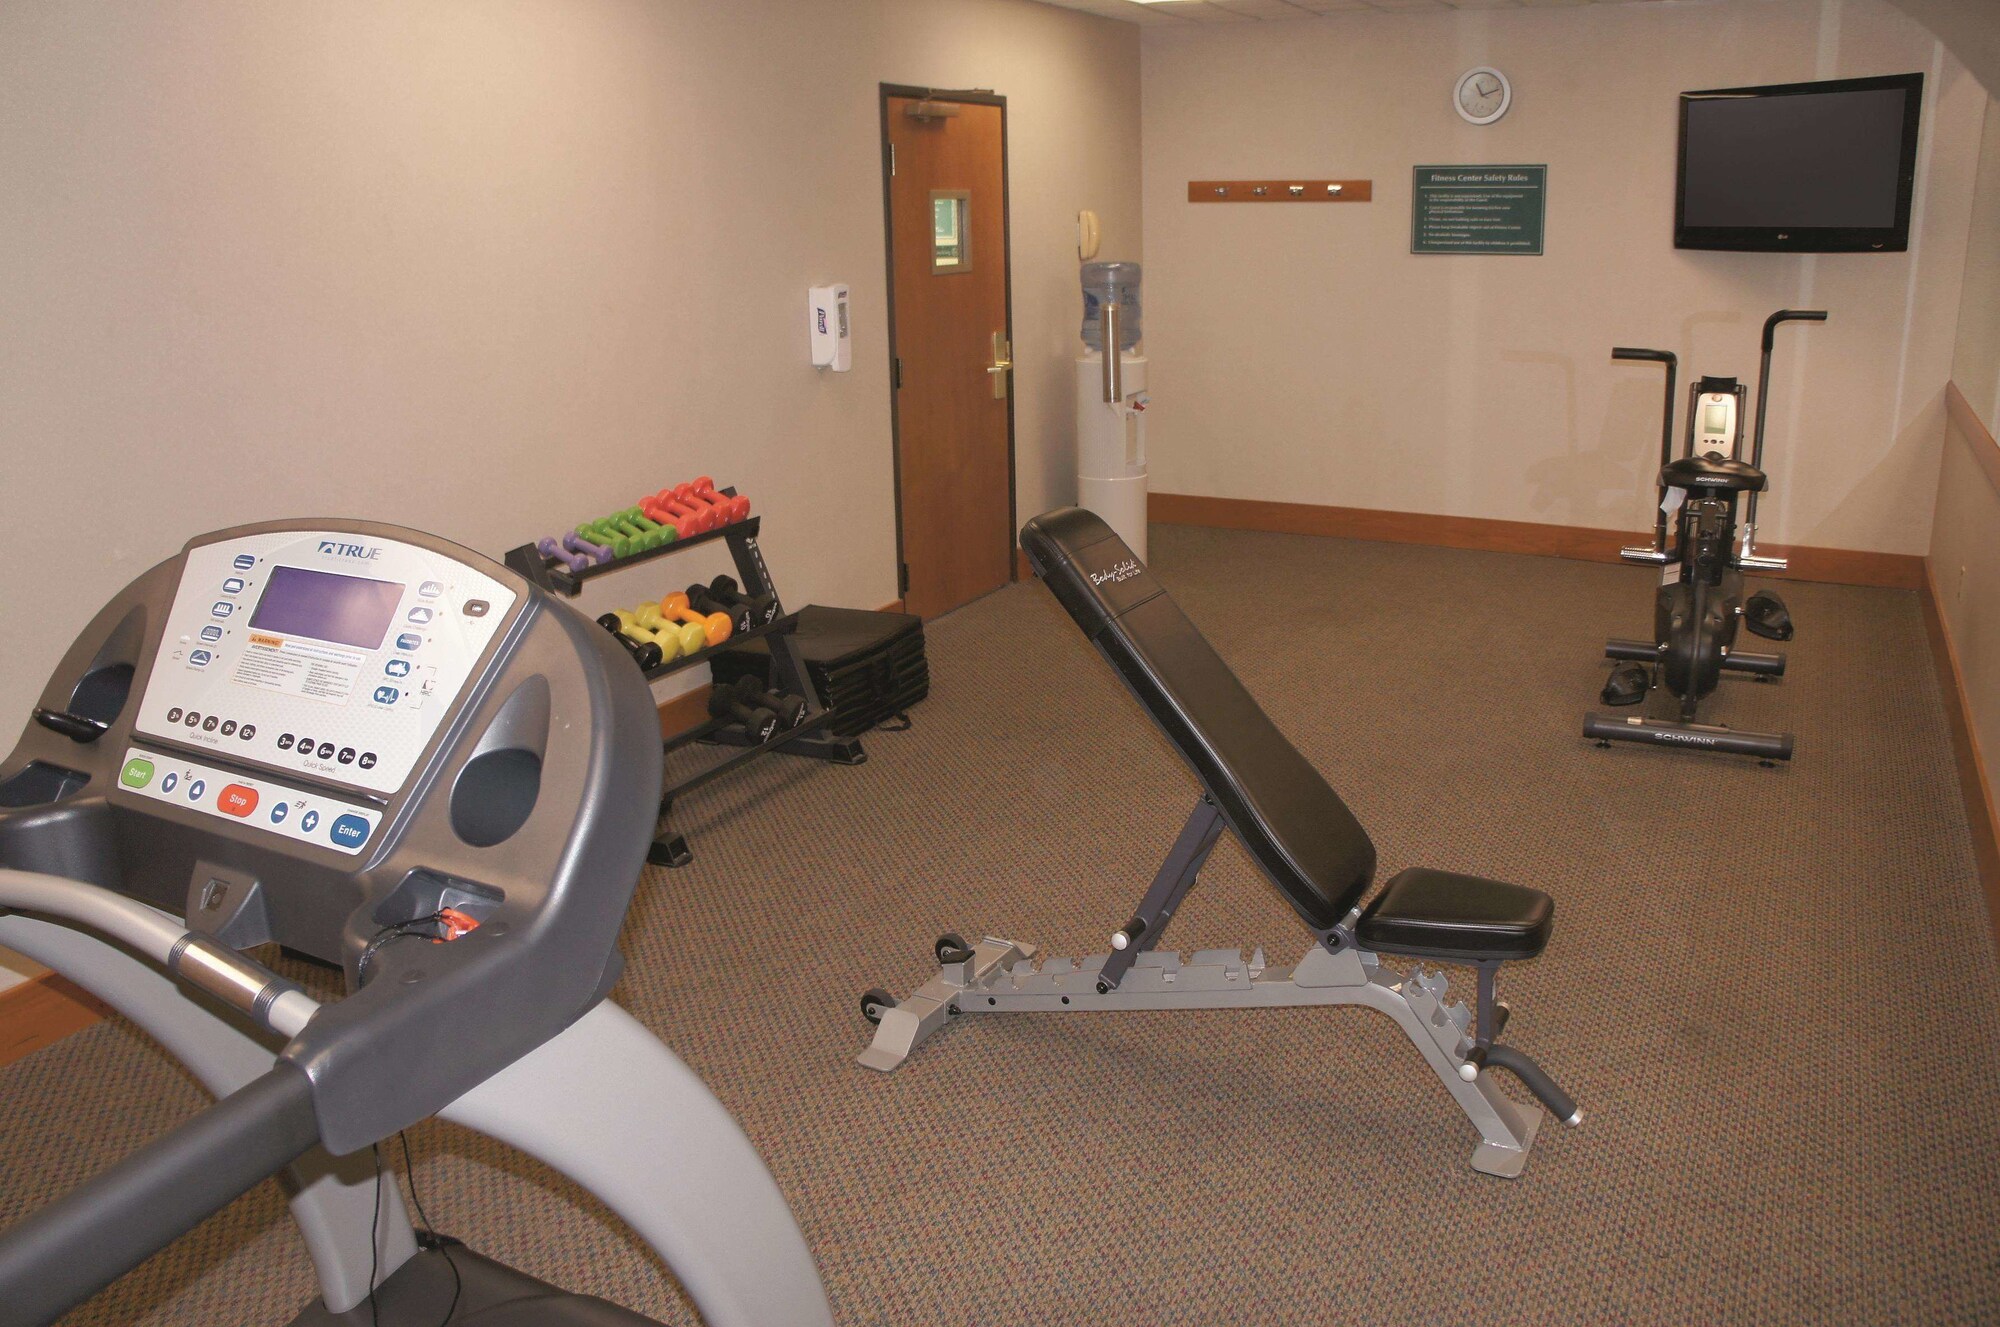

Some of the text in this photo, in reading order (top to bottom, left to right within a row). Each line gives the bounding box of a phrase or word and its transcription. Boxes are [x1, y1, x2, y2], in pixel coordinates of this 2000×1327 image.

[1431, 174, 1528, 183] Fitness Center Safety Rules
[337, 543, 383, 560] TRUE
[189, 731, 219, 745] Quick Incline
[1654, 733, 1716, 745] SCHWINN
[128, 767, 147, 779] Start
[302, 759, 336, 775] Quick Speed
[229, 793, 248, 806] Stop
[337, 824, 362, 839] Enter
